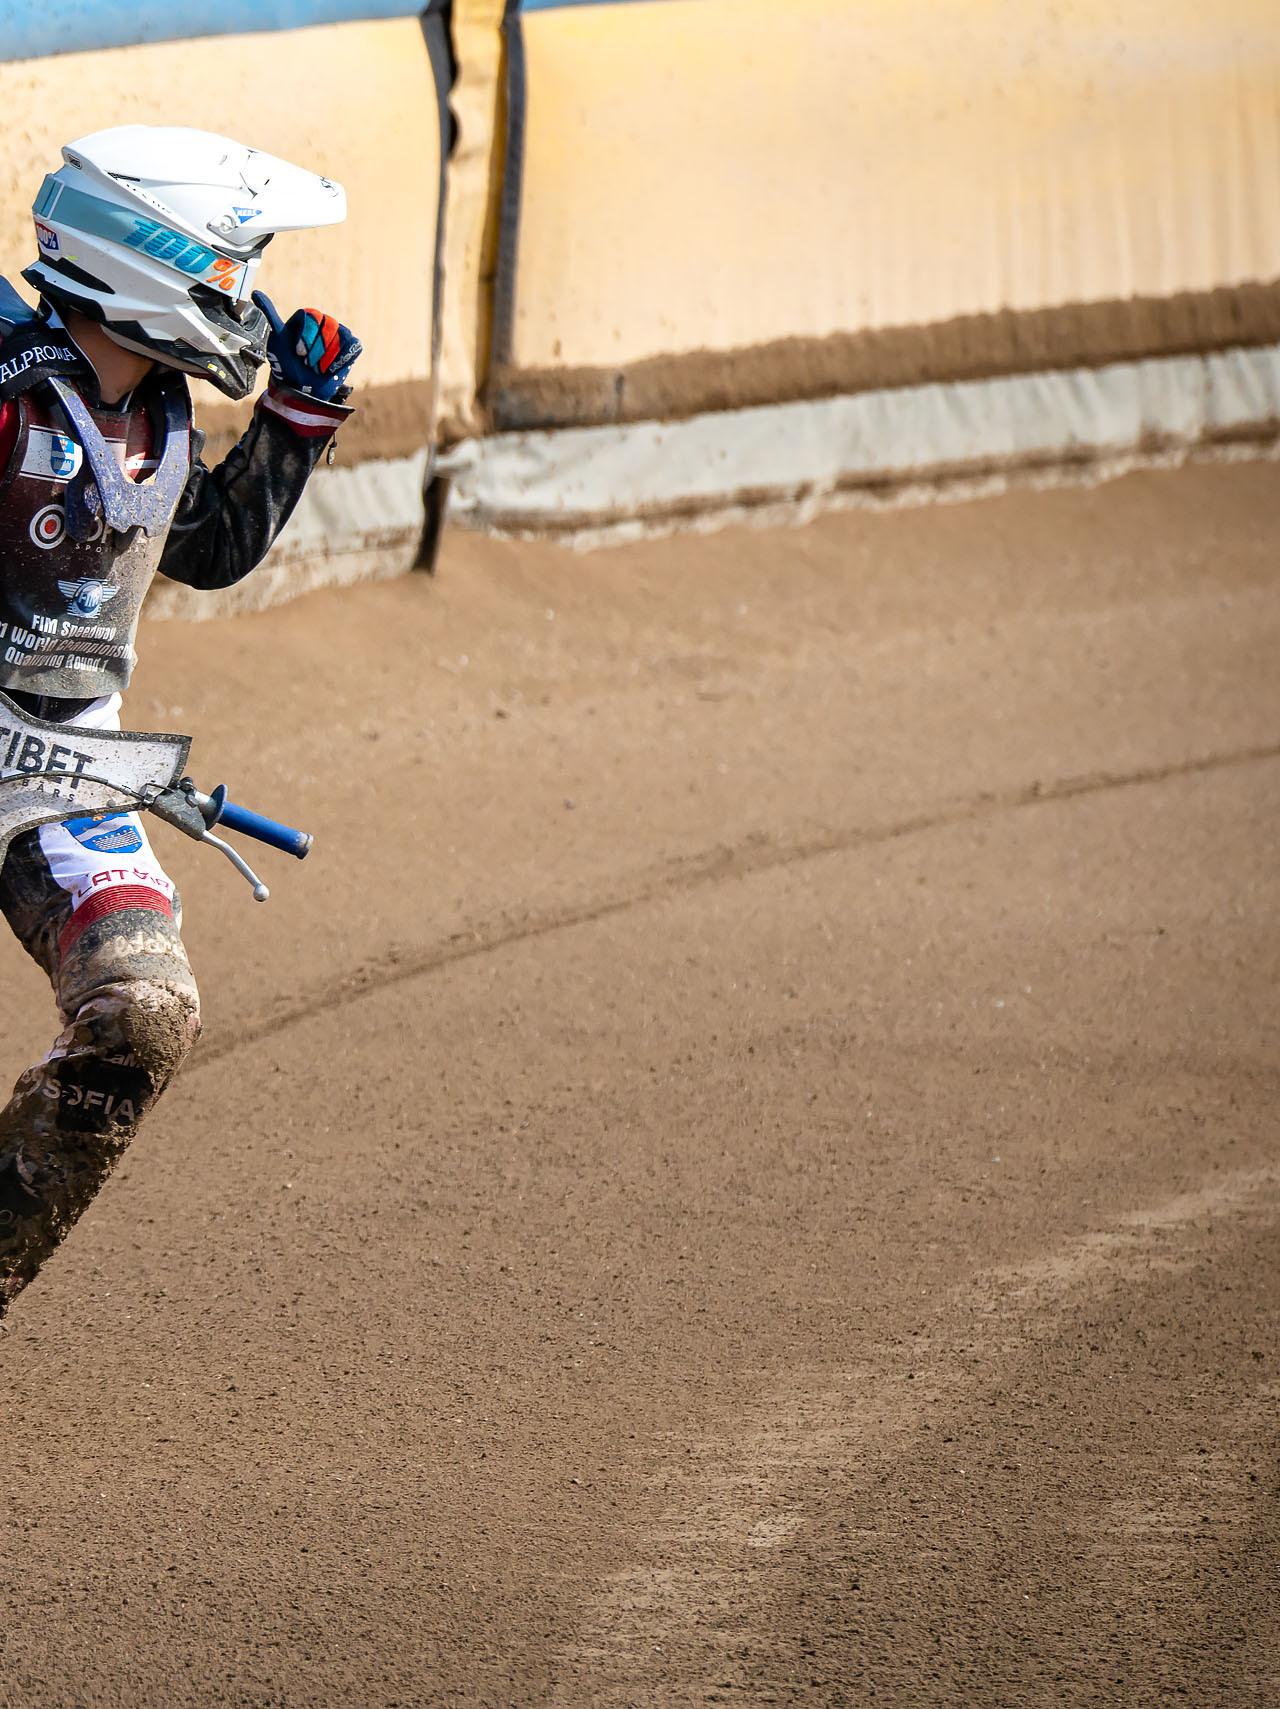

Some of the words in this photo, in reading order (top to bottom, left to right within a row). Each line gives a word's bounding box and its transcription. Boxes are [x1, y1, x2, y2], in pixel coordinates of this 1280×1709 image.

[123, 219, 243, 291] 100%
[0, 345, 77, 384] ALPROMA
[10, 626, 58, 652] World
[31, 614, 58, 635] FIM
[61, 621, 117, 642] Speedway
[65, 653, 102, 672] Round
